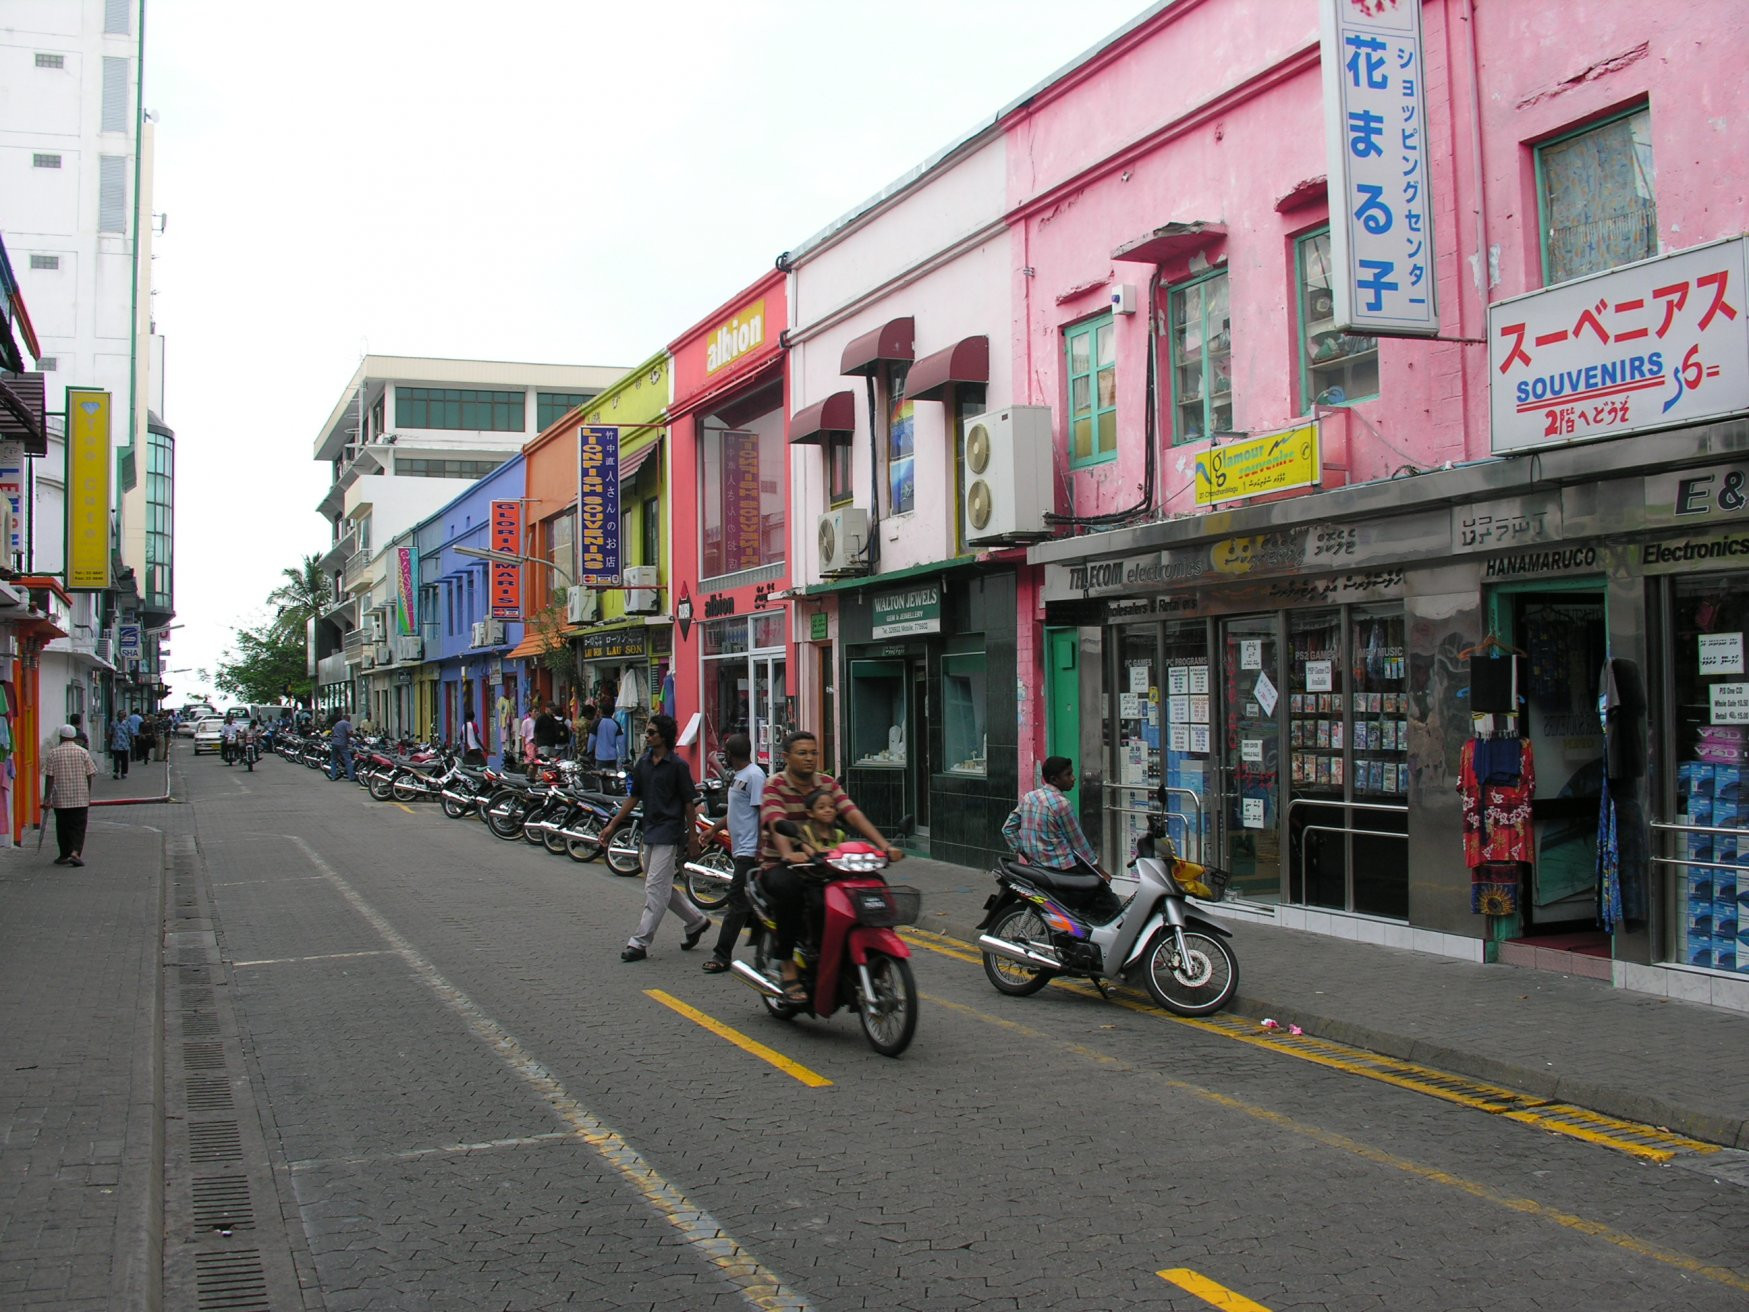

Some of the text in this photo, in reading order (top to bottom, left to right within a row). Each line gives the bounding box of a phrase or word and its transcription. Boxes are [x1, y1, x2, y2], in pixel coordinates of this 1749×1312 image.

[1345, 34, 1398, 312] 花まる子
[1396, 47, 1425, 304] ショッピングセンター
[1500, 270, 1737, 375] スーベニアス
[707, 313, 762, 373] albion
[1516, 351, 1664, 403] SOUVENIRS
[583, 428, 603, 493] LIONFISH
[1674, 470, 1747, 516] E &
[583, 496, 604, 570] SOUVENIRS
[1486, 547, 1597, 577] HANAMARUCO
[1643, 535, 1749, 565] Electronics
[1069, 560, 1203, 590] TELECOM electronics
[705, 593, 735, 618] albion
[874, 588, 937, 612] WALTON JEWELS
[625, 644, 642, 655] SON
[1132, 658, 1152, 667] GAMES
[1174, 656, 1207, 666] PROGRAMS
[1295, 649, 1336, 660] PS2 GAMES
[1377, 646, 1403, 657] MUSIC
